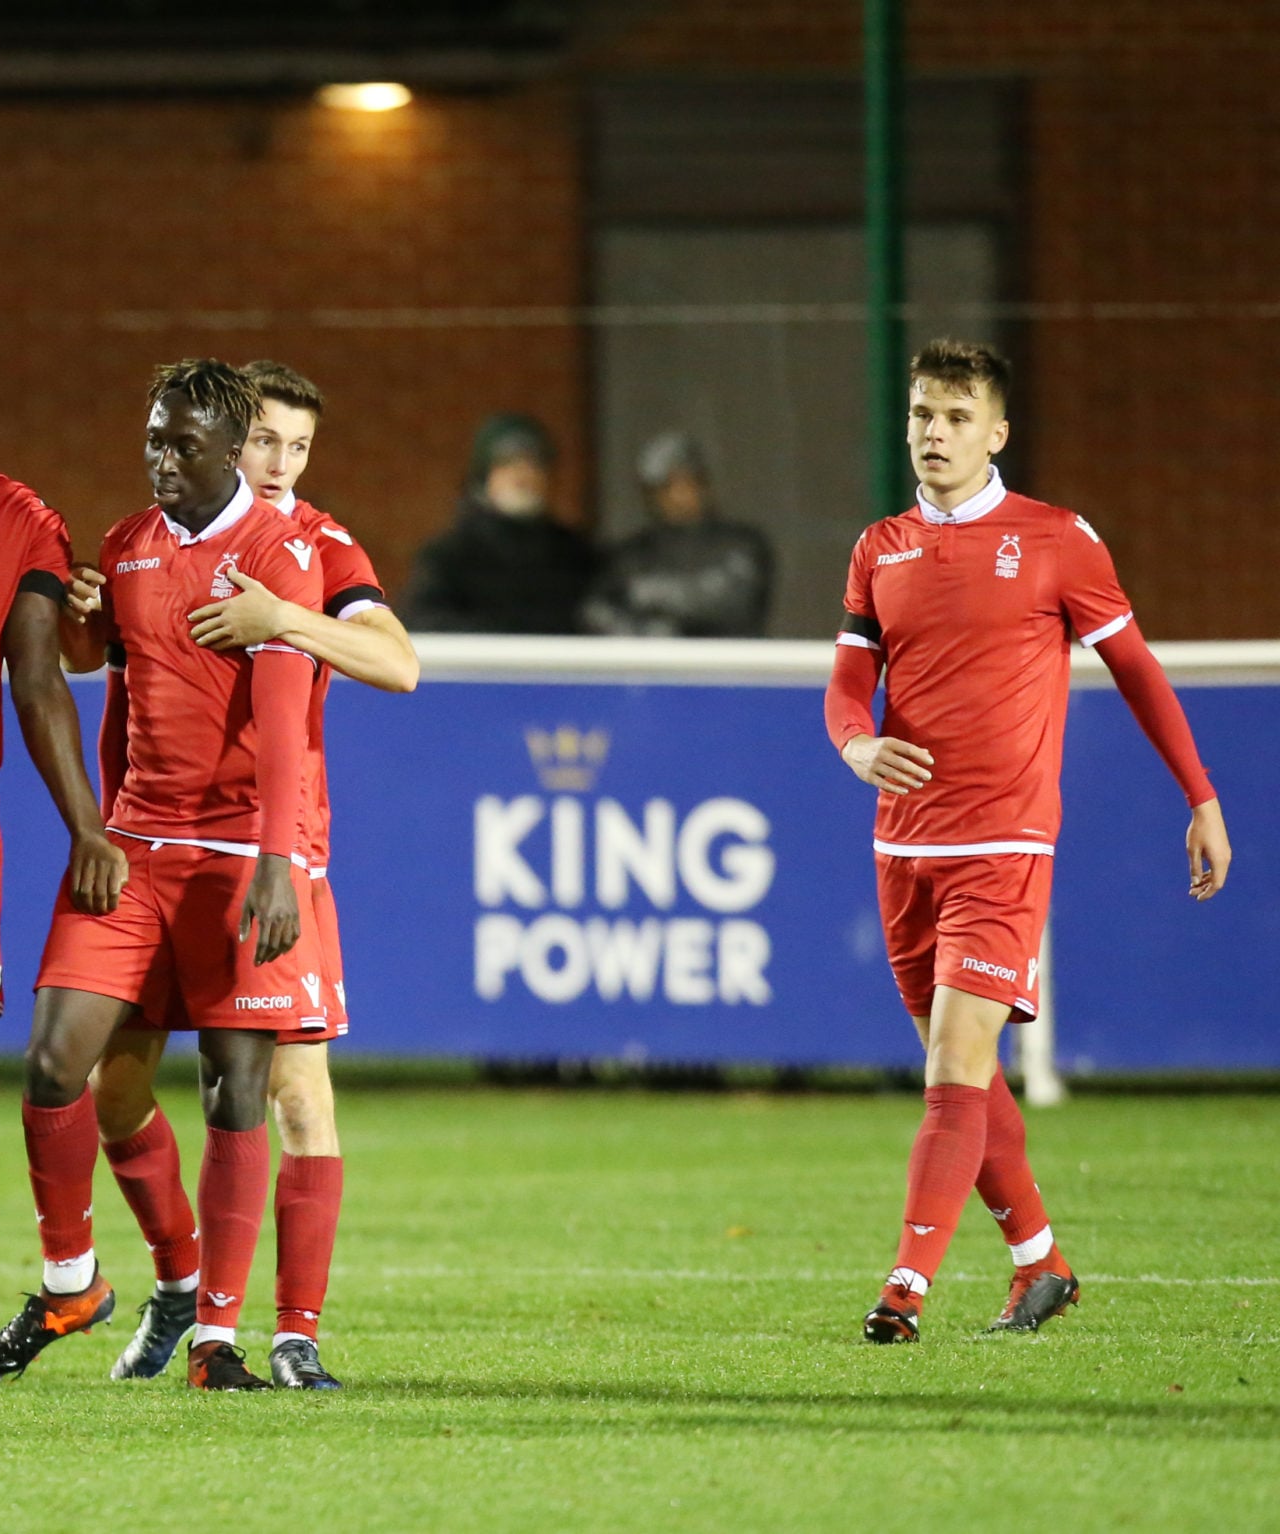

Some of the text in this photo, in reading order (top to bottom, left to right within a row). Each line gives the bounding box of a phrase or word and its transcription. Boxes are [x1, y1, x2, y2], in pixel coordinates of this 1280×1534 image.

[116, 557, 161, 575] macron
[876, 547, 923, 566] macron
[473, 795, 776, 914] KING
[473, 912, 773, 1006] POWER
[961, 957, 1018, 983] macron
[235, 995, 293, 1010] macron
